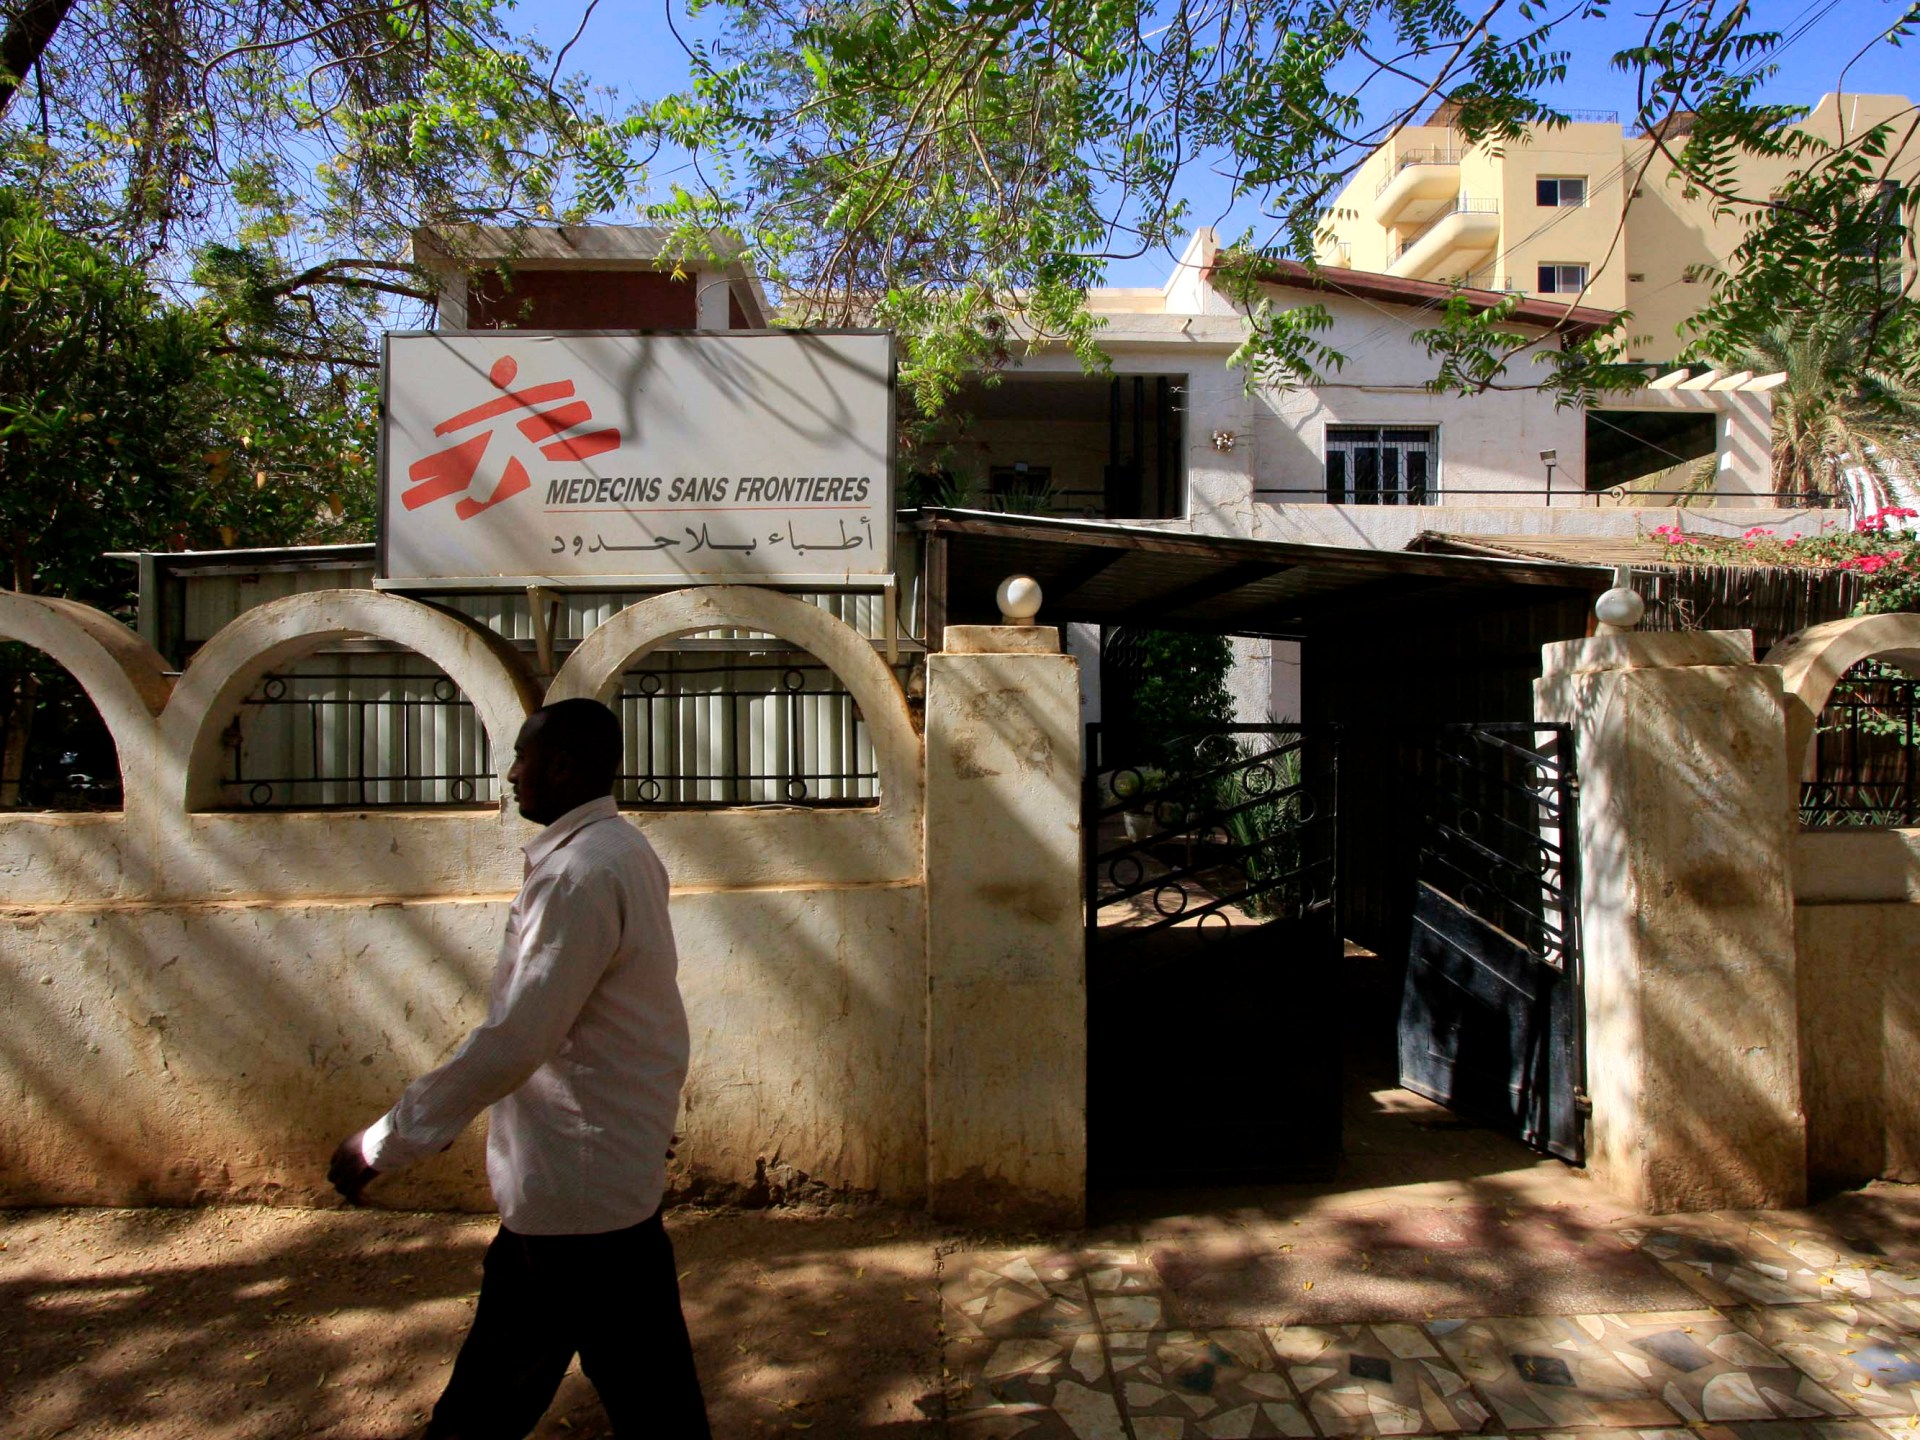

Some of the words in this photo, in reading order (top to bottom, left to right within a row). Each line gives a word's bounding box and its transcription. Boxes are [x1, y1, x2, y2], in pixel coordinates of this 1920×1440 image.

[546, 477, 662, 504] MEDECINS
[667, 477, 729, 502] SANS
[734, 476, 870, 502] FRONTIERES
